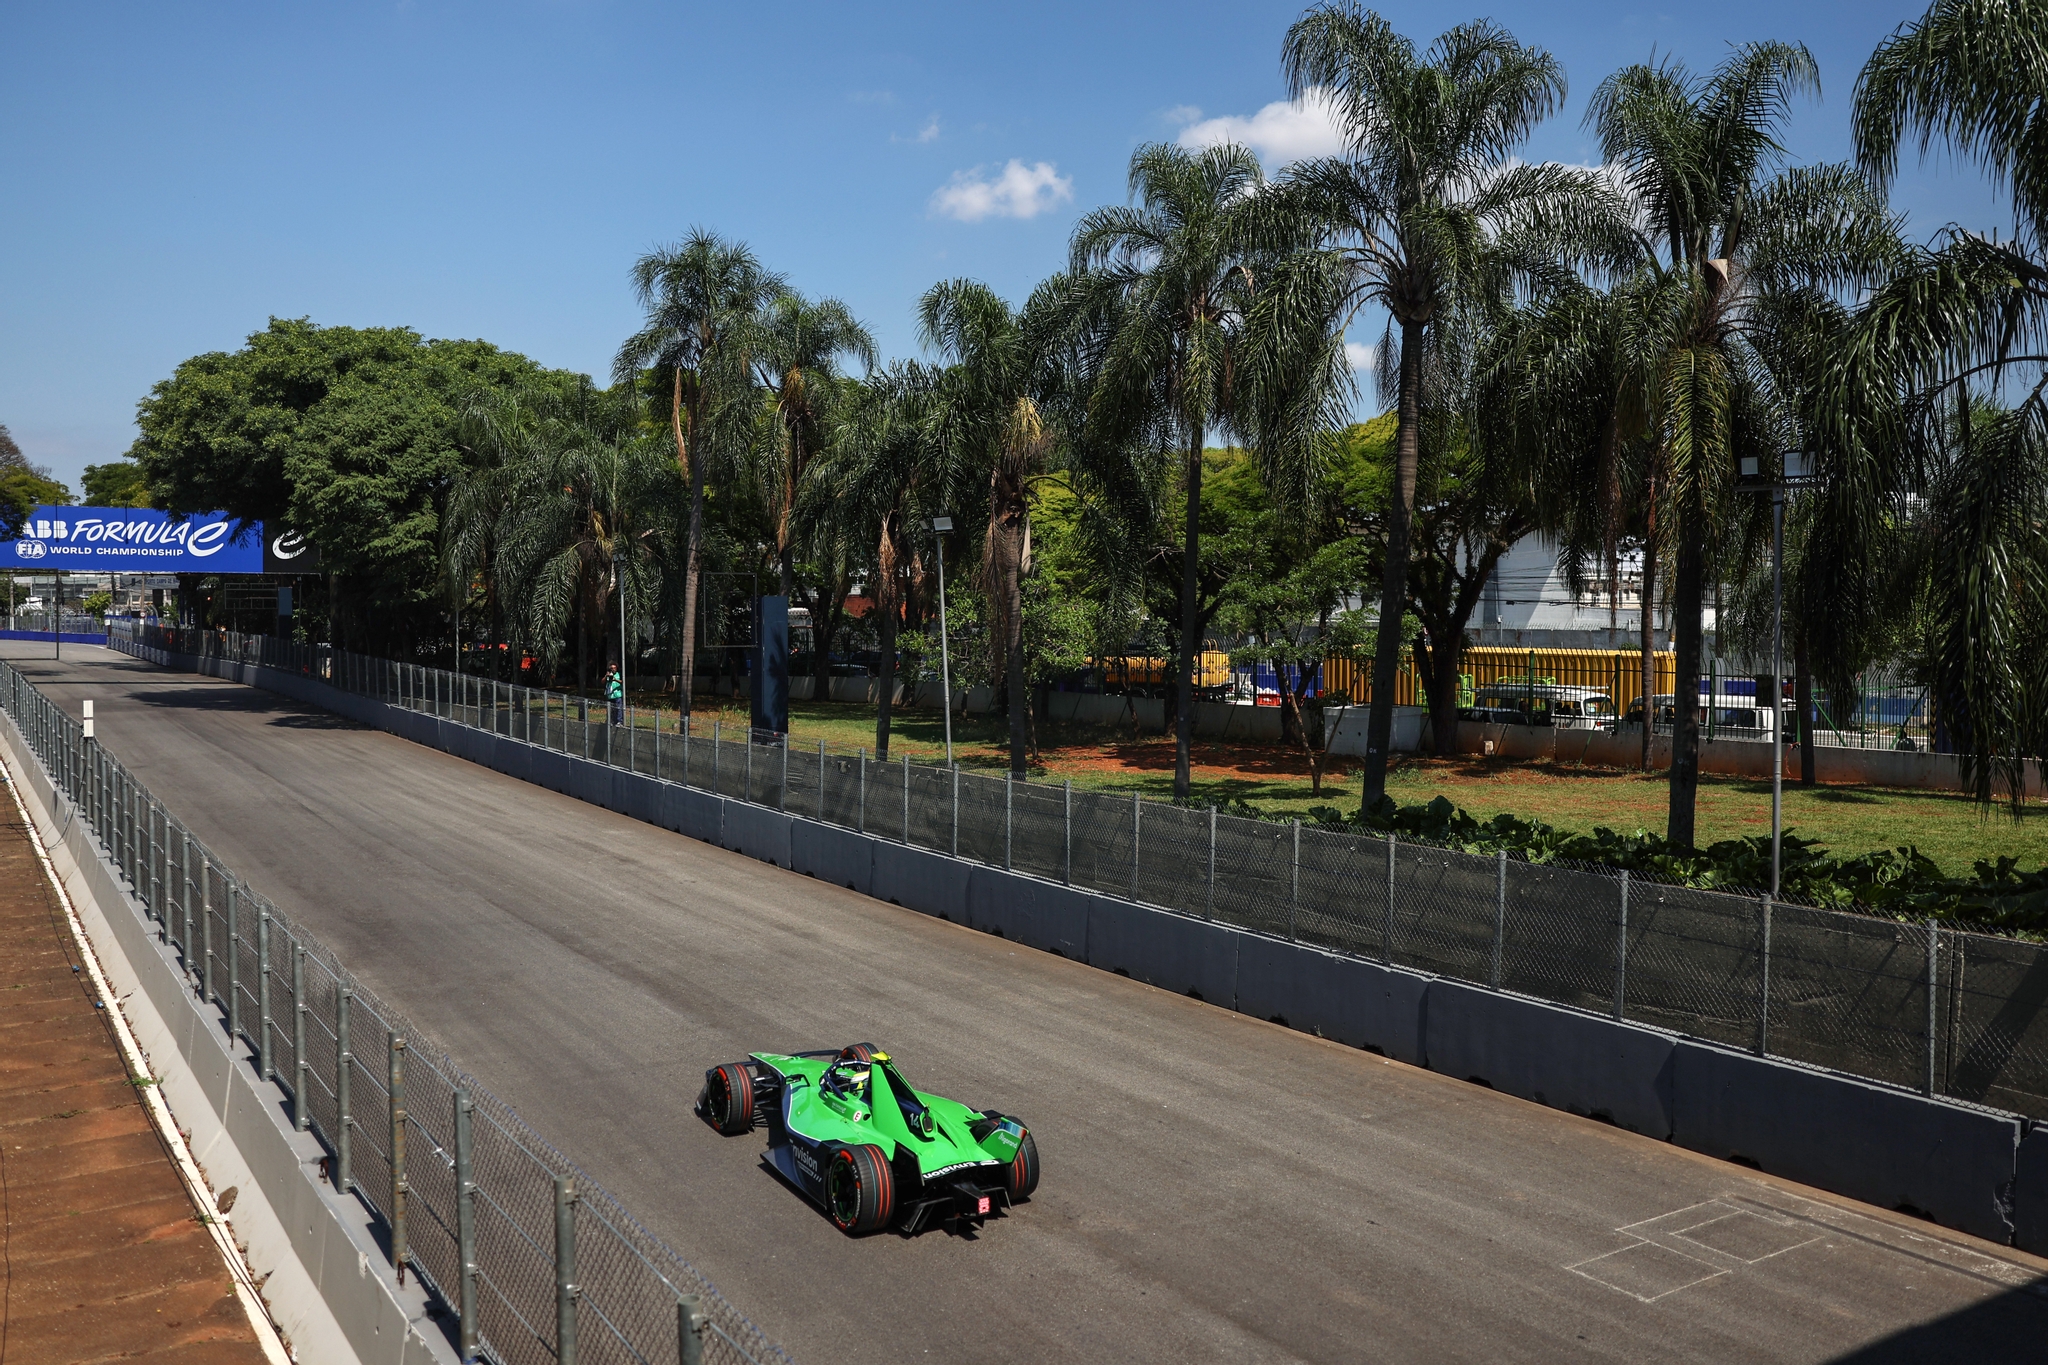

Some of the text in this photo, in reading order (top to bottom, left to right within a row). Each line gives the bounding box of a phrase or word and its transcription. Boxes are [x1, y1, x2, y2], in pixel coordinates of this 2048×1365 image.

[20, 520, 69, 539] ABB
[70, 519, 191, 545] FORMULA
[50, 546, 184, 557] WORLD CHAMPIONSHIP
[909, 1112, 921, 1129] 14
[789, 1139, 818, 1173] nvision
